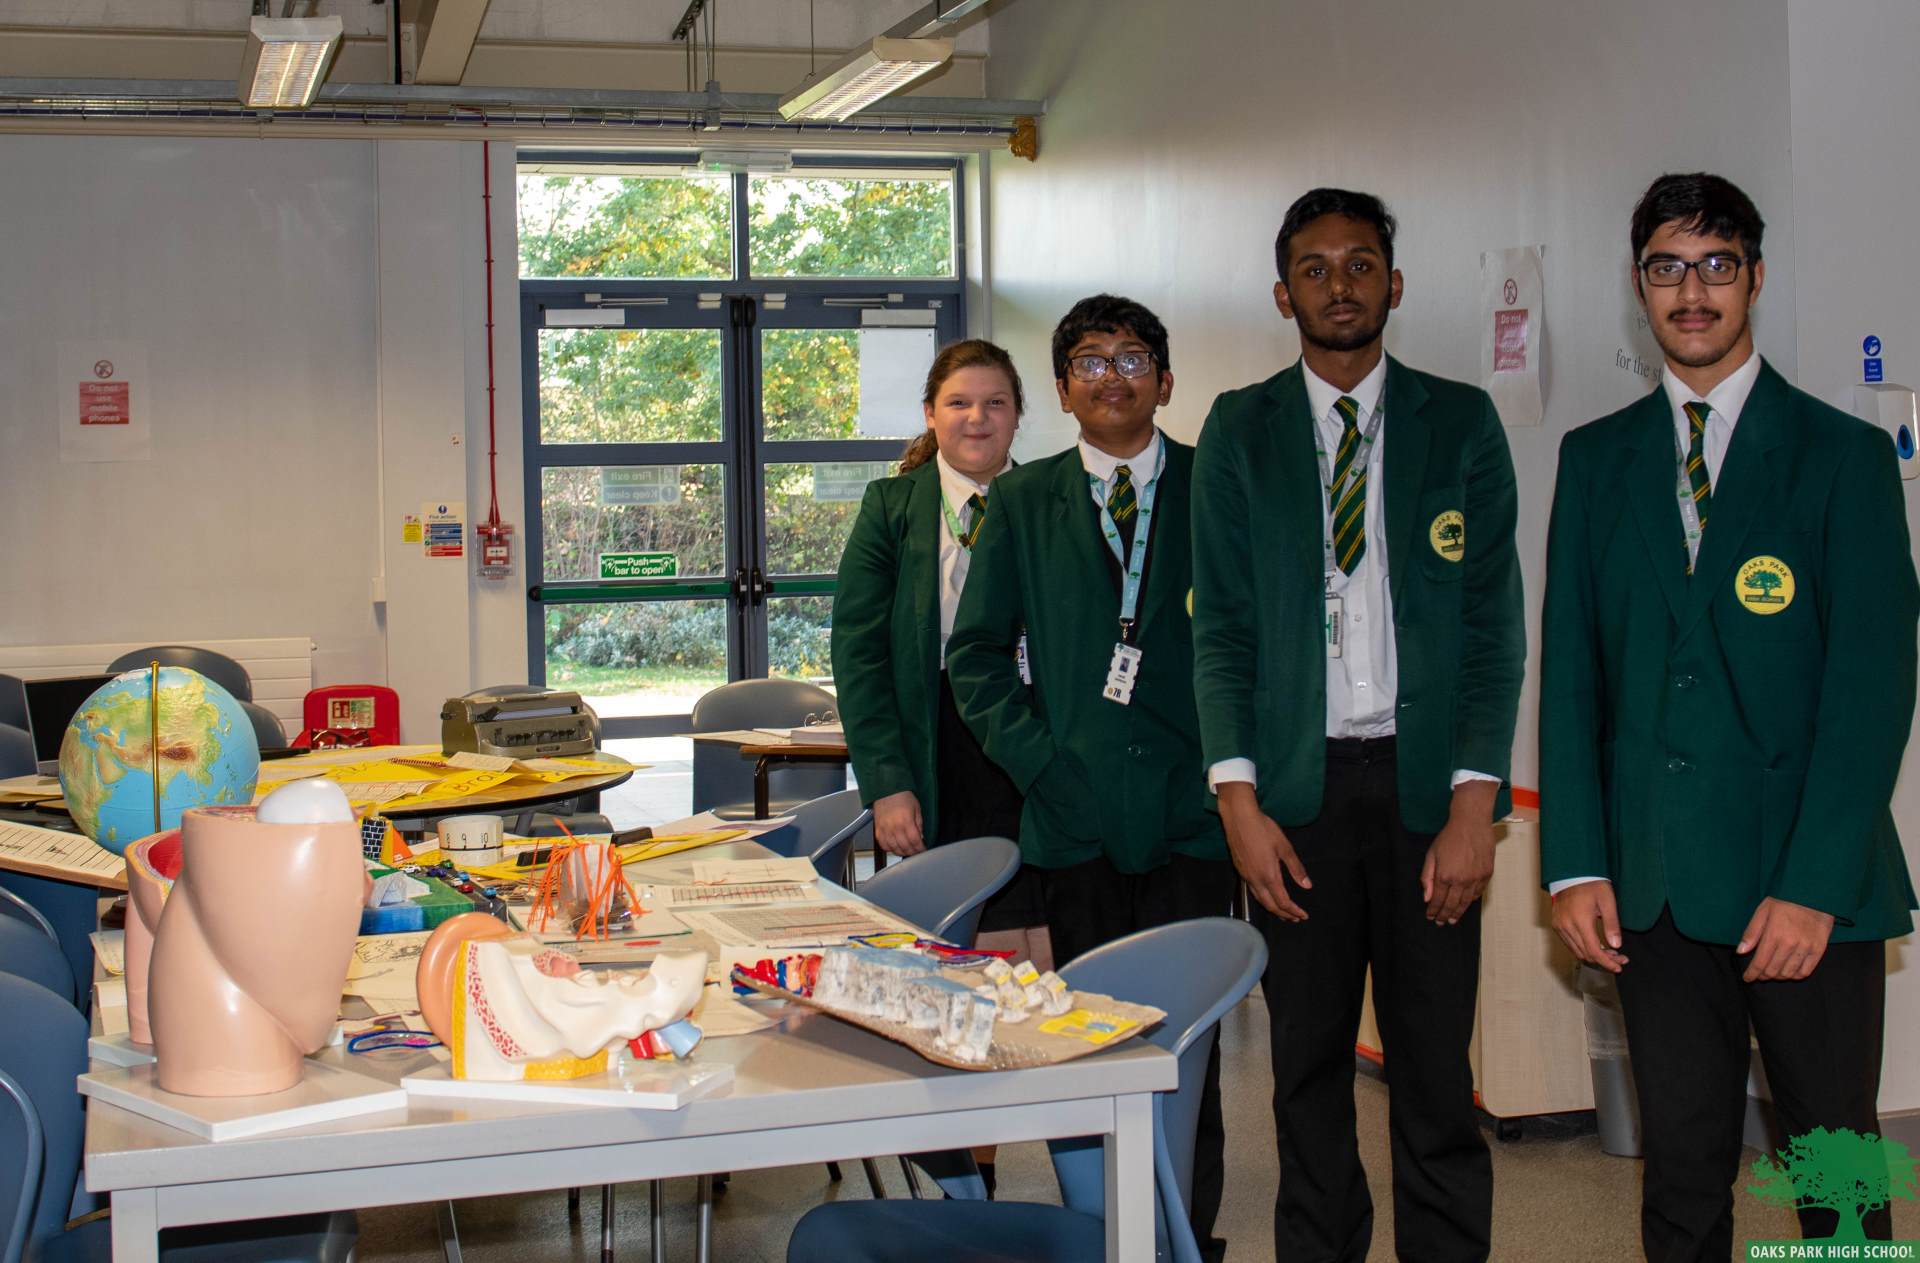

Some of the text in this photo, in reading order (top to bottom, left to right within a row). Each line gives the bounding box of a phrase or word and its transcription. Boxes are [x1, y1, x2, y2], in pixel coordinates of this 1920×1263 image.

[1615, 347, 1632, 370] for
[1633, 355, 1650, 378] the
[89, 384, 101, 392] Do
[88, 414, 120, 424] phones
[627, 557, 649, 566] Push
[614, 566, 664, 576] bar to open
[1743, 560, 1788, 578] OAKS PARK
